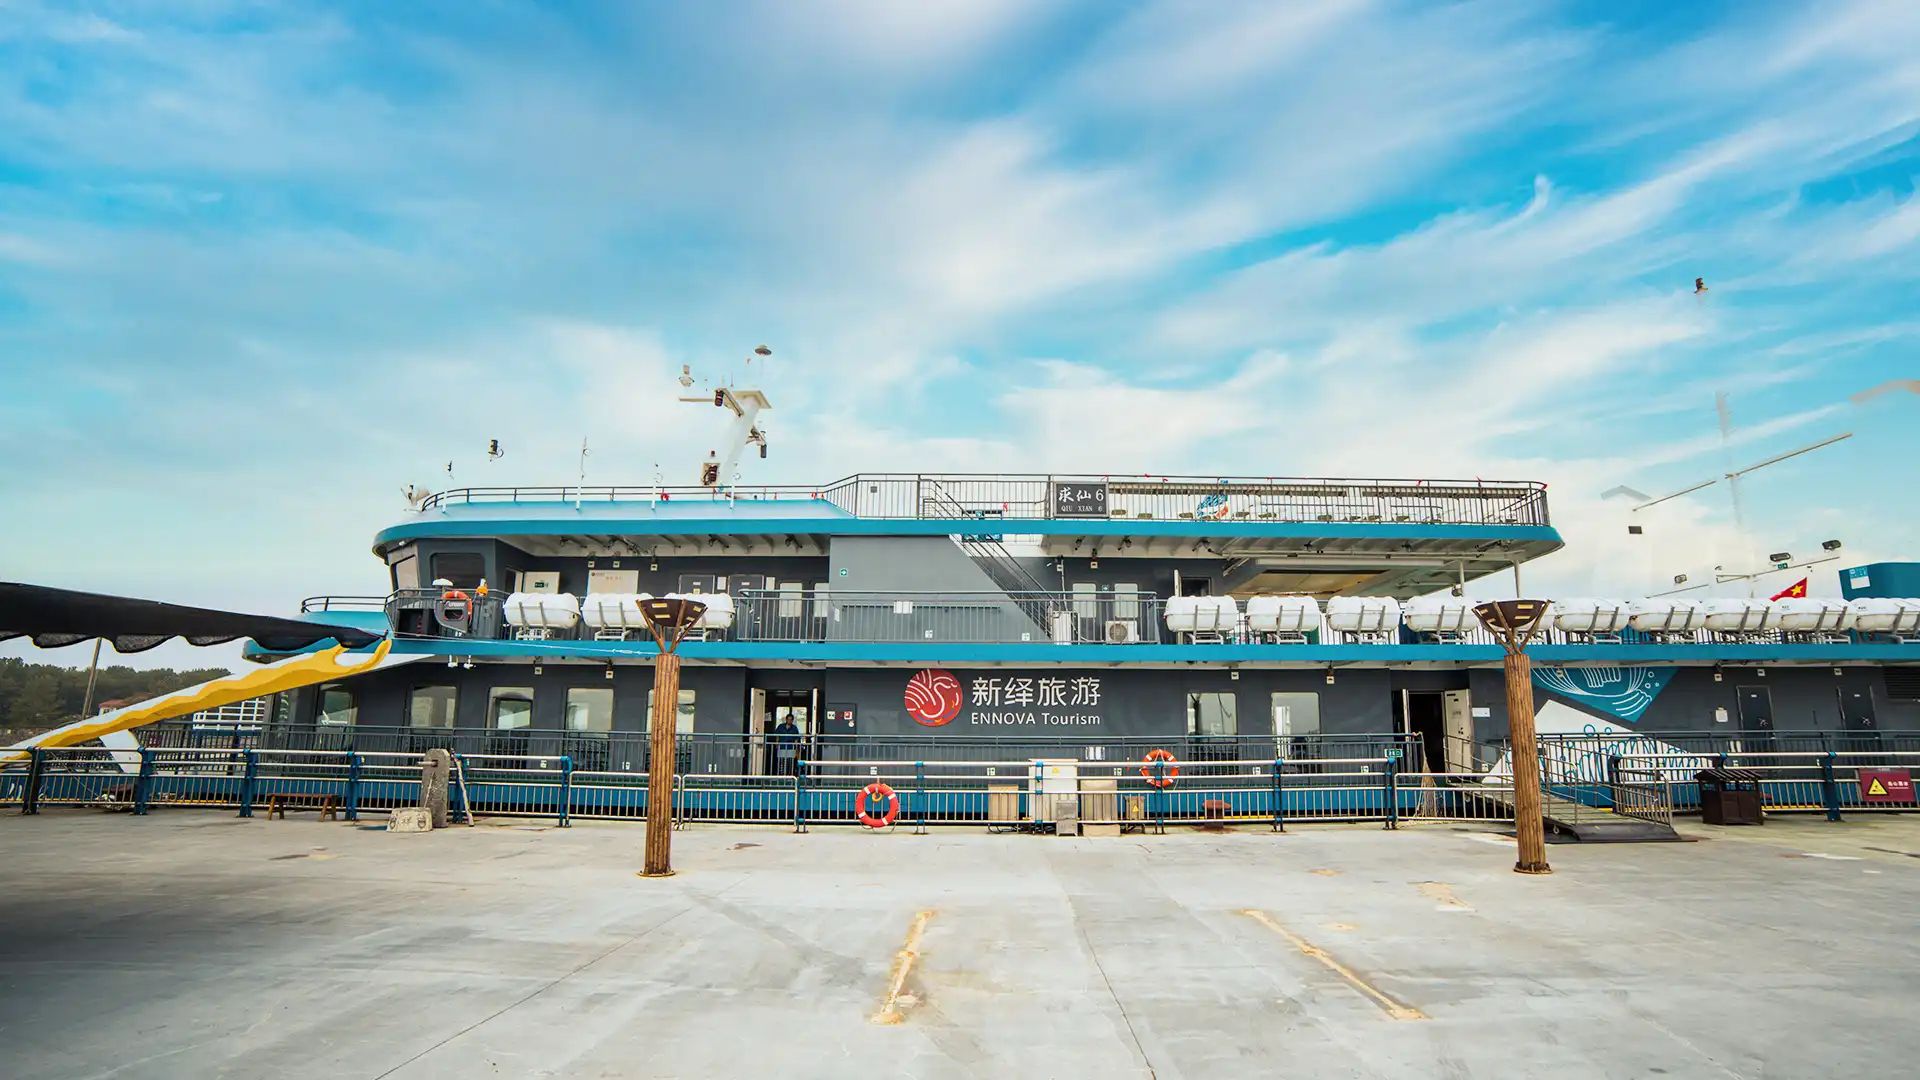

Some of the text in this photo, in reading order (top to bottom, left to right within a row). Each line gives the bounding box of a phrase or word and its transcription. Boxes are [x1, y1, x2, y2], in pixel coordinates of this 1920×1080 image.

[972, 676, 1101, 707] 新绎旅游
[971, 712, 1101, 725] ENNOVA Tourism
